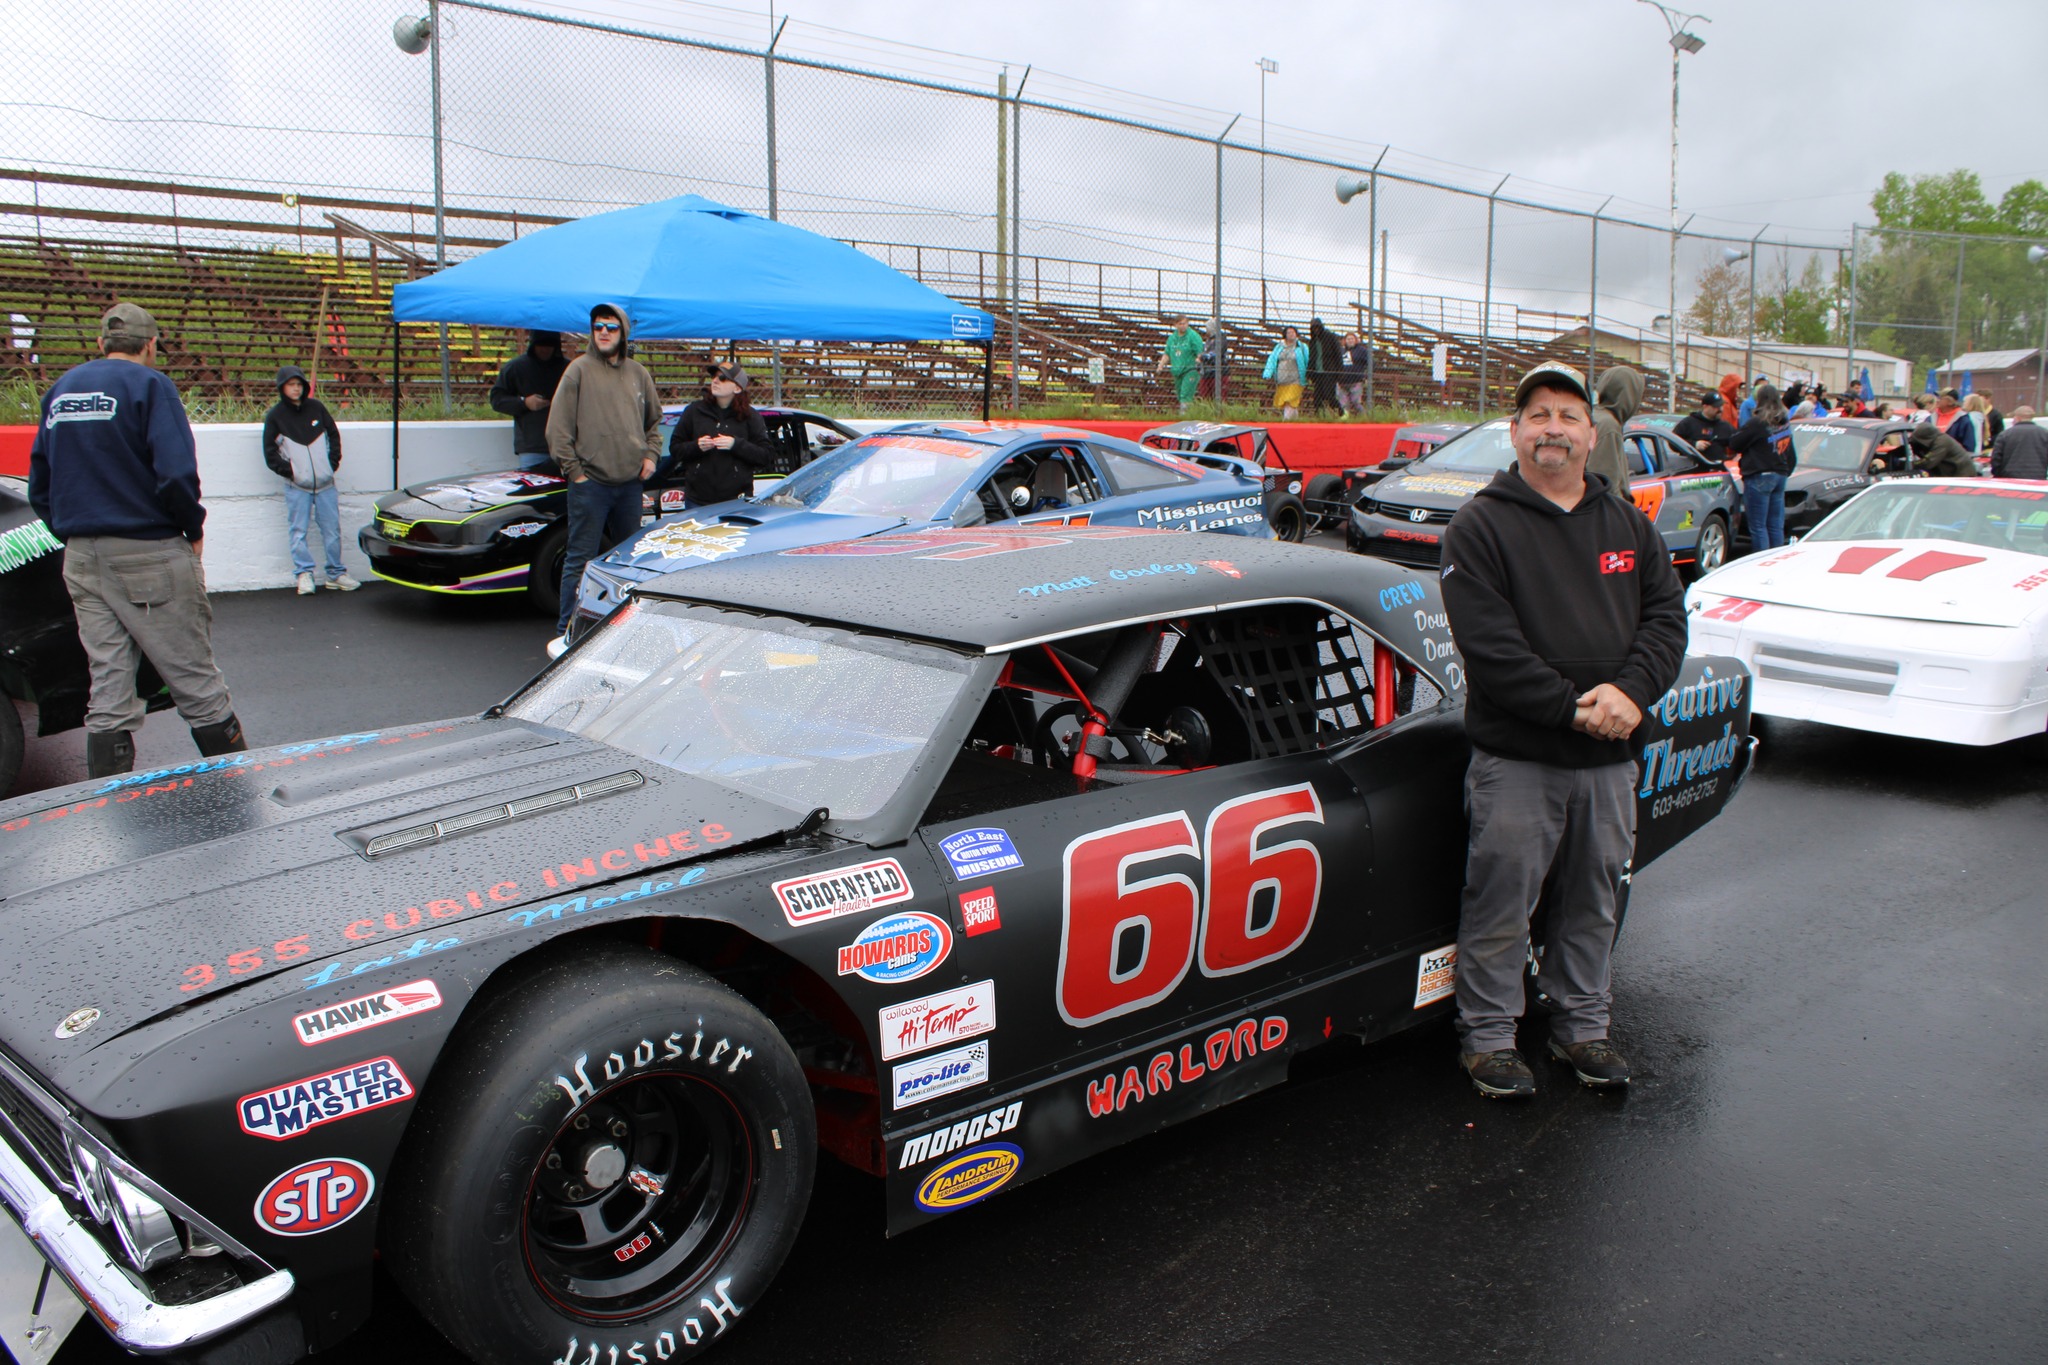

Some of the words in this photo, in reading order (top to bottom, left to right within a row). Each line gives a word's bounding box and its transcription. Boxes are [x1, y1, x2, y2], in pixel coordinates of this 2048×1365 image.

[1793, 423, 1847, 435] Hastings
[1137, 493, 1263, 526] Missisquoi
[1189, 512, 1263, 533] Lanes
[1018, 576, 1099, 597] Matt
[1379, 580, 1426, 612] CREW
[1701, 597, 1765, 623] 29
[1647, 666, 1744, 727] reative
[1639, 720, 1738, 799] Threads
[1651, 777, 1719, 820] 603-466-2752
[944, 833, 977, 853] North
[976, 831, 1005, 842] East
[956, 854, 1020, 876] MUSEUM
[178, 933, 311, 992] 355
[343, 880, 522, 941] CUBIC
[541, 822, 734, 889] INCHES
[785, 867, 901, 914] SCHOENFELD
[832, 893, 871, 916] Headers
[963, 895, 995, 916] SPEED
[1056, 781, 1324, 1028] 66
[301, 936, 464, 991] Late
[507, 866, 707, 928] Model
[965, 906, 996, 927] SPORT
[838, 928, 932, 973] HOWARDS
[887, 952, 917, 970] cams
[300, 994, 393, 1037] HAWK
[306, 998, 439, 1041] PERFORMANCE
[886, 1000, 929, 1021] wilwood
[554, 1017, 753, 1122] Hoosier
[897, 1061, 971, 1098] pro-lite
[904, 1070, 985, 1100] www.colemanracing.com
[1086, 1015, 1289, 1118] WARLORD
[243, 1060, 392, 1129] QUARTER
[274, 1077, 406, 1136] MASTER
[898, 1100, 1023, 1170] MOROSO
[273, 1165, 358, 1227] STP
[925, 1152, 1014, 1205] LANDRUM
[936, 1177, 981, 1199] PERFORMANCE
[981, 1165, 1010, 1181] SPRINGS
[614, 1231, 652, 1262] 66
